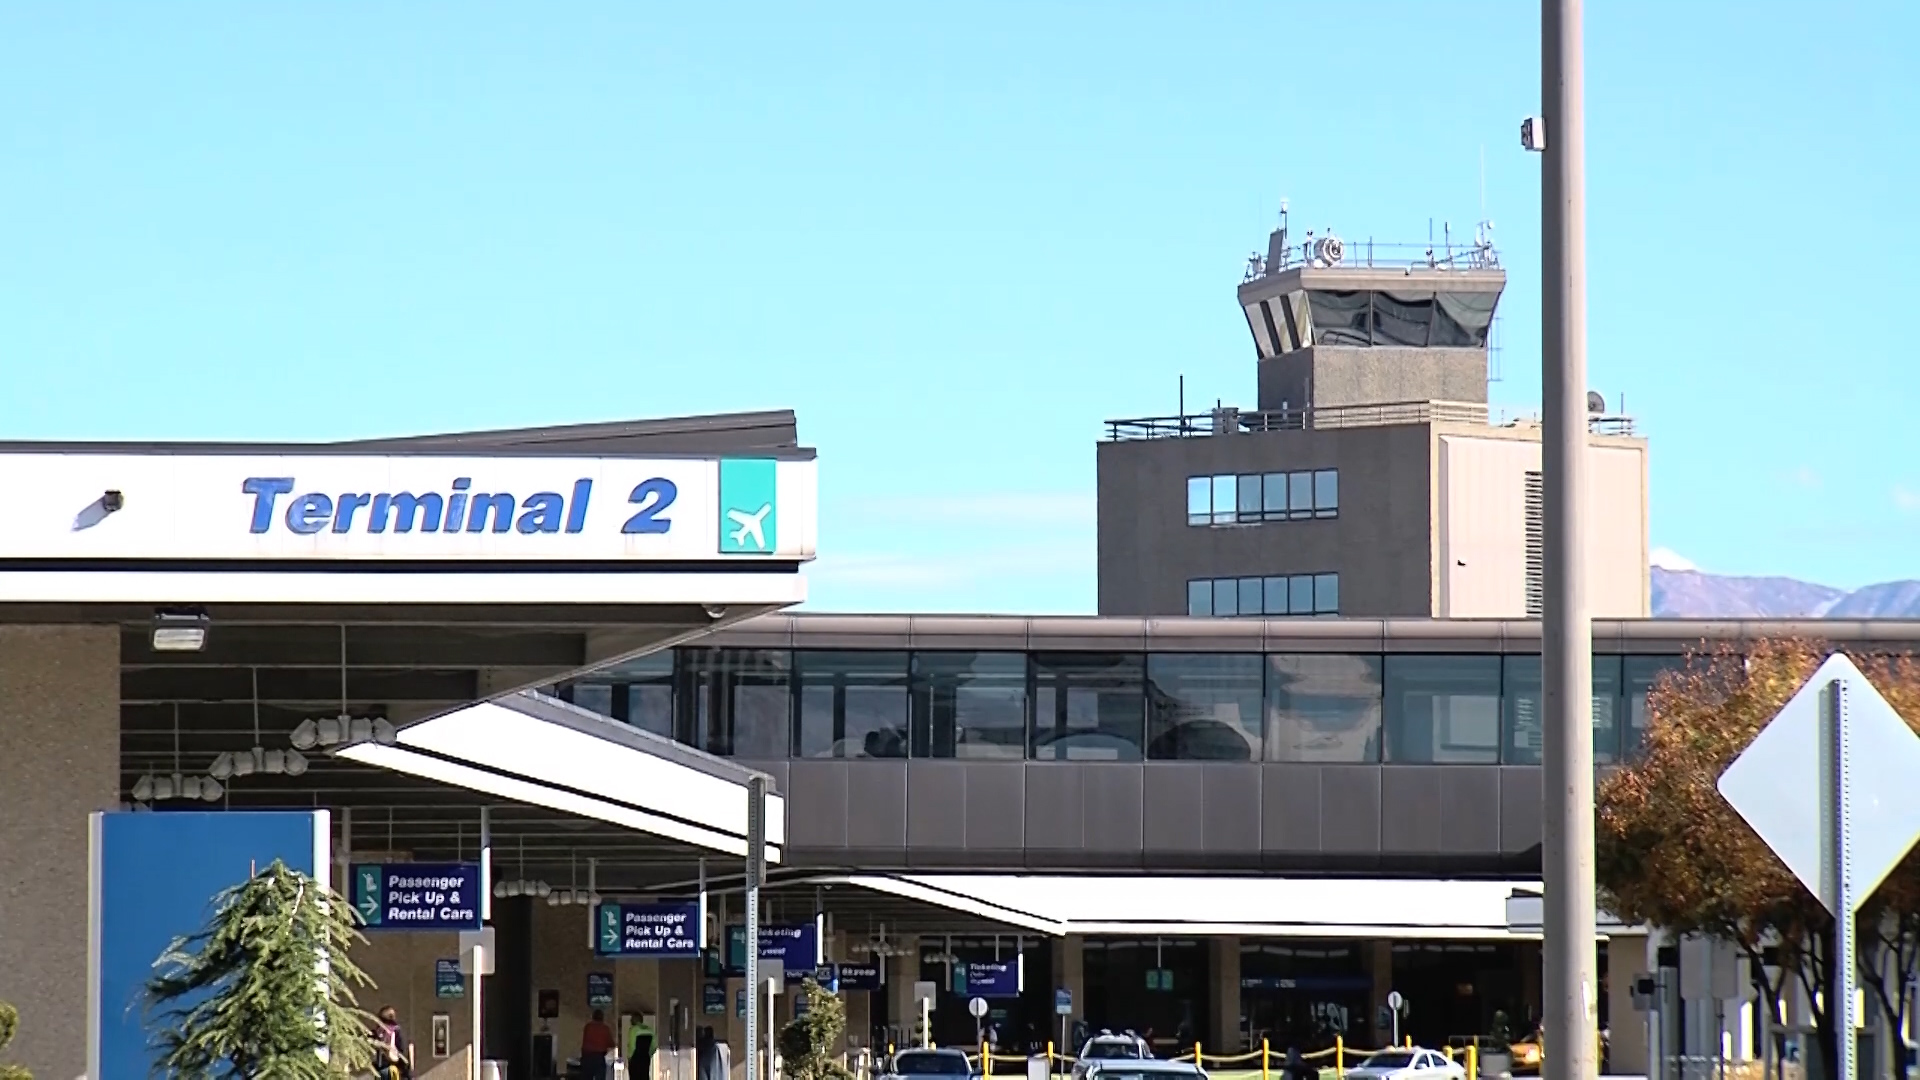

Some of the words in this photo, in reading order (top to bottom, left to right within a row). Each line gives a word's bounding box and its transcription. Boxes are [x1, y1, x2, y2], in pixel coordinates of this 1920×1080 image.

[242, 477, 594, 535] Terminal
[620, 477, 678, 535] 2
[389, 875, 464, 890] Passenger
[389, 891, 420, 904] Pick
[425, 891, 445, 905] Up
[450, 891, 461, 904] &
[388, 907, 435, 920] Rental
[440, 907, 473, 920] Cars
[626, 912, 687, 924] Passenger
[626, 925, 651, 936] Pick
[655, 925, 671, 937] Up
[626, 938, 663, 948] Rental
[667, 938, 694, 948] Cars
